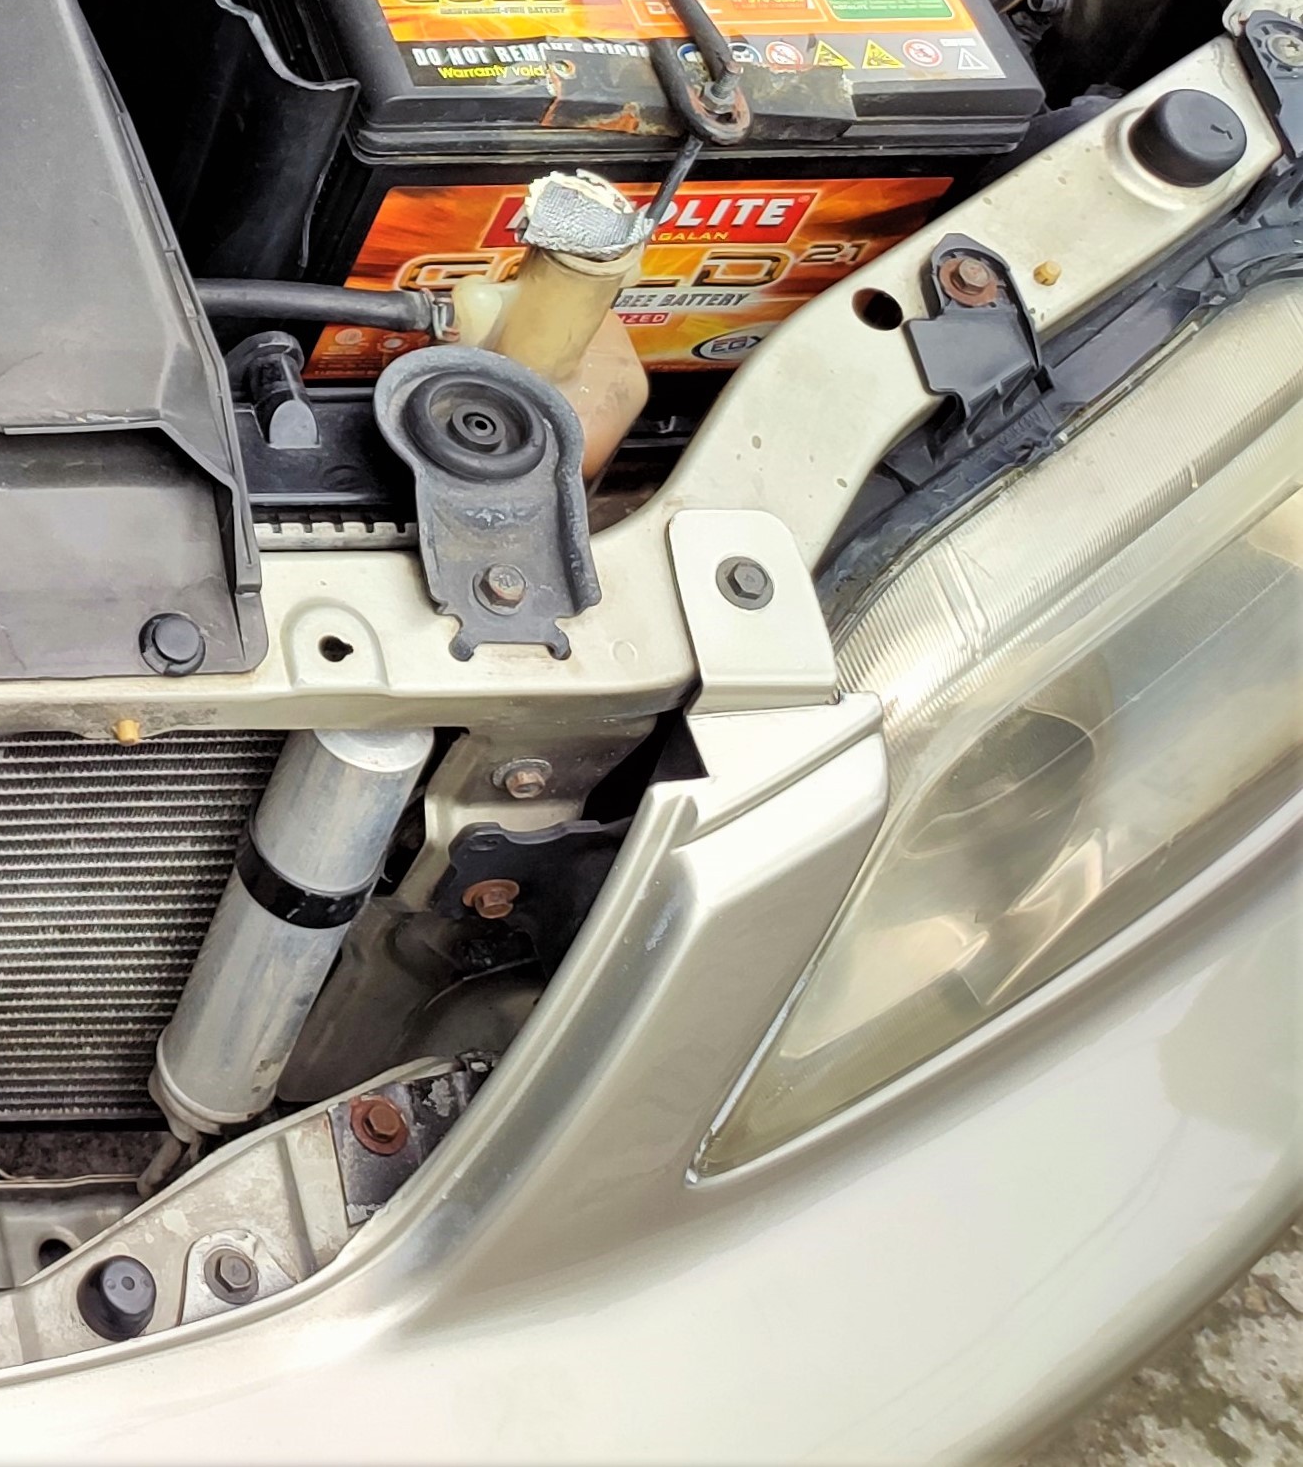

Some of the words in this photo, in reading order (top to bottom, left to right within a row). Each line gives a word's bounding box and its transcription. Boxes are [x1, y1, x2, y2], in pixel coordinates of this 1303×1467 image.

[411, 48, 443, 67] DO
[447, 46, 490, 65] NOT
[437, 64, 508, 79] Warranty
[799, 241, 866, 264] 21
[658, 292, 751, 308] BATTERY
